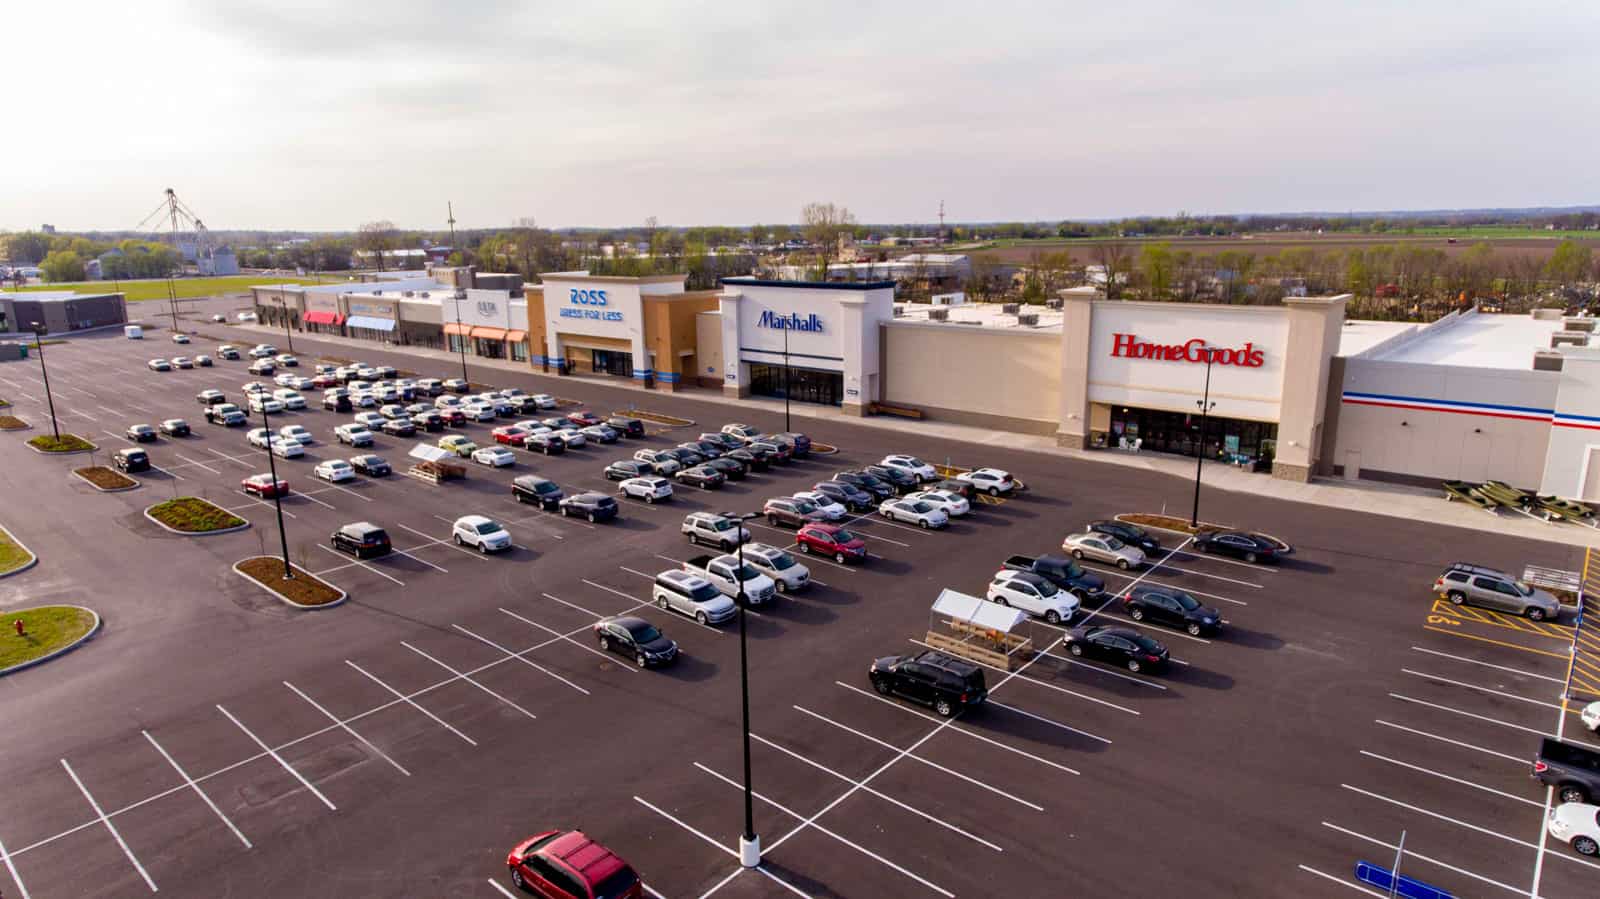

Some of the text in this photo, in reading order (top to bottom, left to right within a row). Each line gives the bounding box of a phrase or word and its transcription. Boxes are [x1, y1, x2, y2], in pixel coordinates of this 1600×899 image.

[570, 288, 607, 305] ROSS
[584, 310, 601, 320] FOR
[602, 311, 623, 321] LESS
[757, 310, 823, 333] Marshalls
[1110, 333, 1264, 367] HomeGoods
